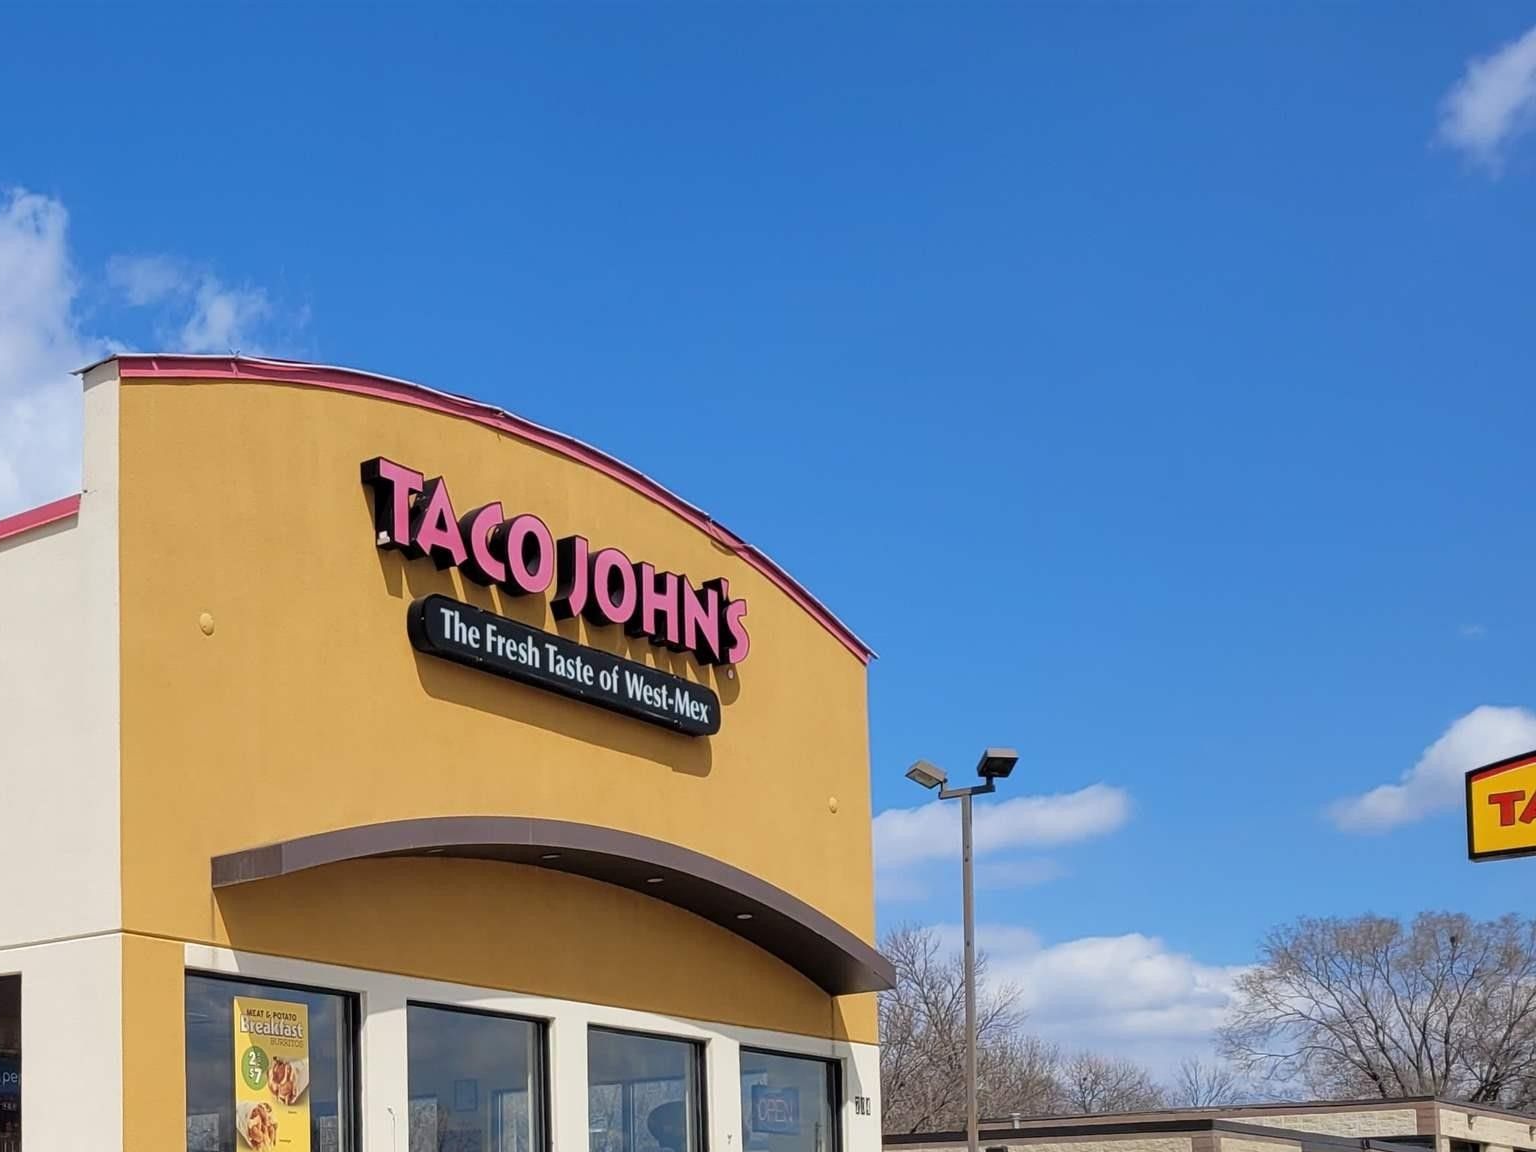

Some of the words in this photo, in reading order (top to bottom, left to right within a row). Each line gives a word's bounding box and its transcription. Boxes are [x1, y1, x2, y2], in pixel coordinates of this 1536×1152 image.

[378, 457, 555, 593] TACO
[569, 536, 750, 663] JOHN'S
[440, 607, 481, 648] The
[486, 623, 541, 669] Fresh
[544, 643, 594, 686] Taste
[599, 665, 620, 694] of
[625, 670, 710, 725] West-Mex
[240, 1014, 304, 1039] Breakfast
[246, 1009, 264, 1018] MEAT
[272, 1011, 297, 1022] POTATO
[758, 1098, 793, 1122] OPEN
